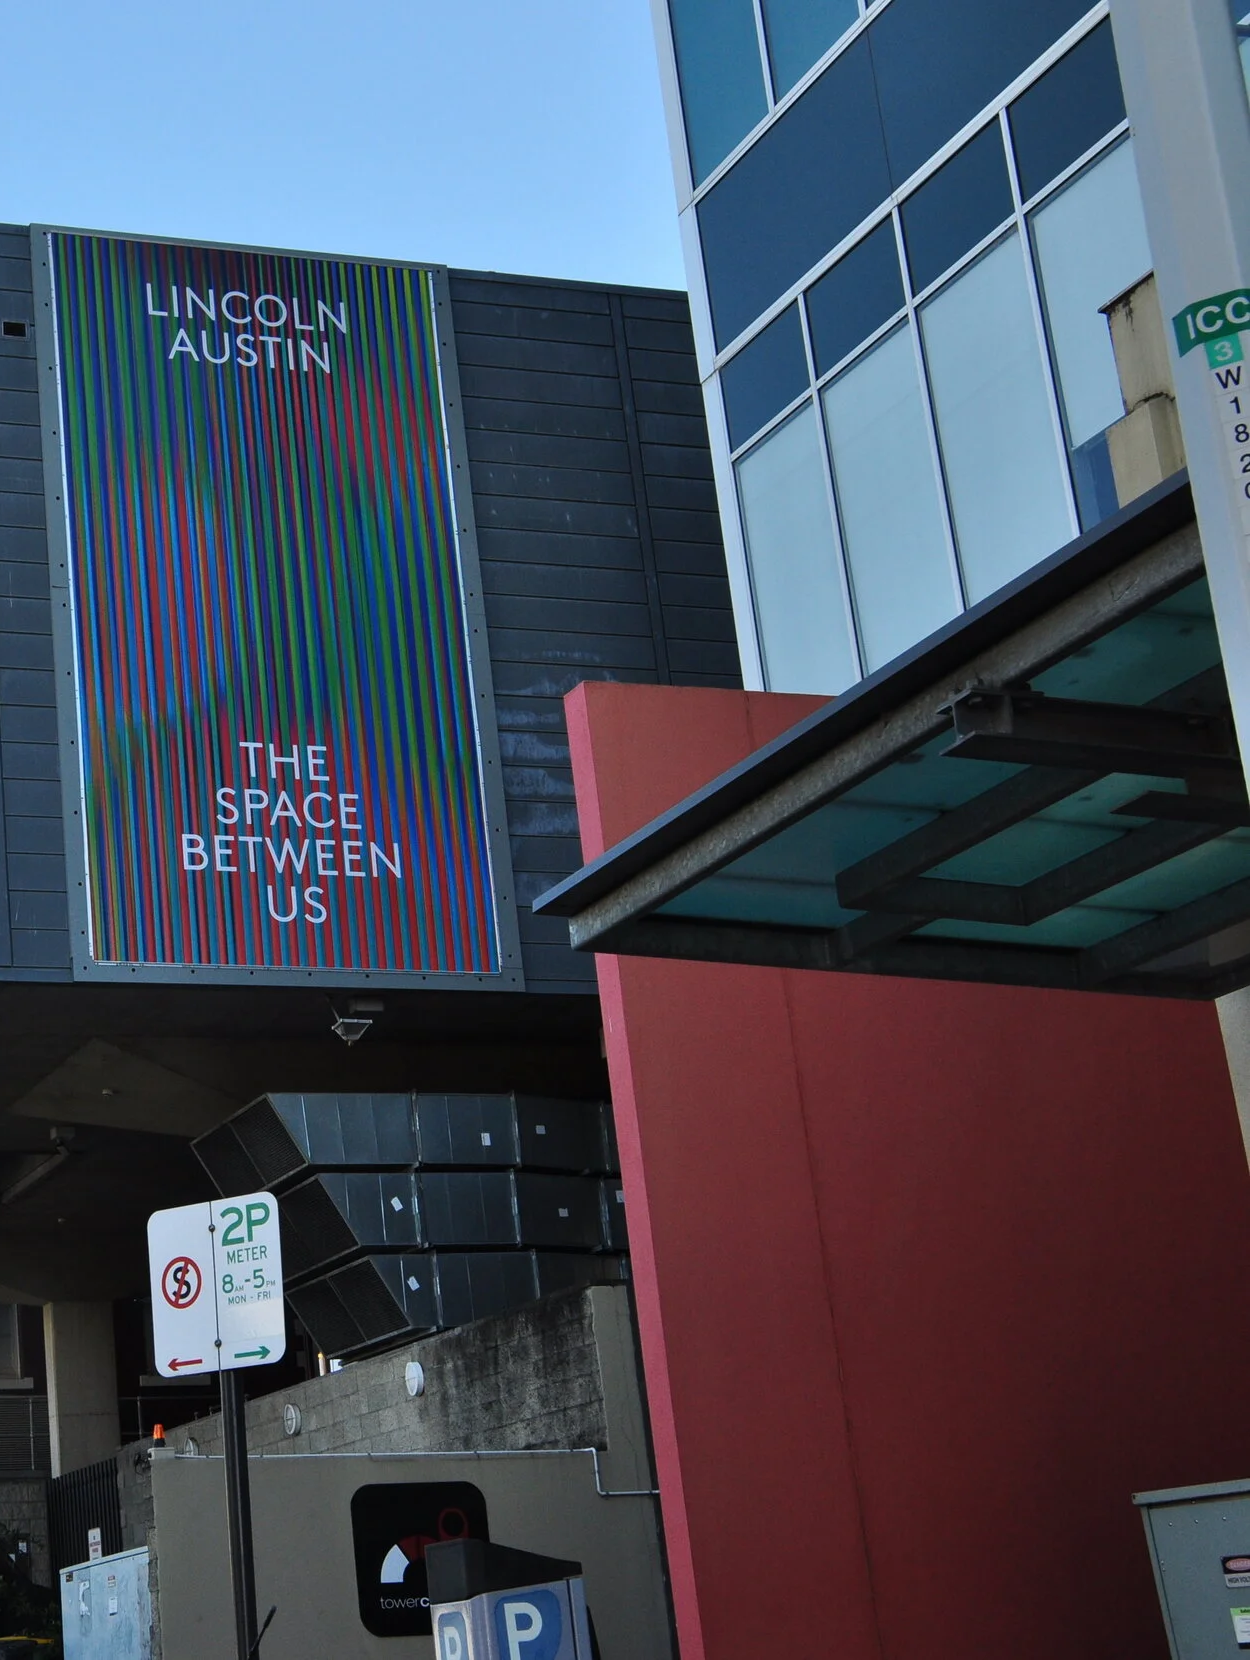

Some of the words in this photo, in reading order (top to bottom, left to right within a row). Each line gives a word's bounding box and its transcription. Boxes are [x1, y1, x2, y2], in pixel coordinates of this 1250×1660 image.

[146, 283, 347, 334] LINCOLN
[168, 328, 330, 374] AUSTIN
[1213, 341, 1234, 361] 3
[239, 742, 330, 781] THE
[216, 787, 362, 830] SPACE
[181, 833, 402, 878] BETWEEN
[267, 885, 328, 924] US
[220, 1202, 270, 1247] 2P
[226, 1246, 268, 1265] METER
[228, 1295, 247, 1305] MON
[257, 1291, 271, 1301] FRI
[380, 1596, 430, 1609] towerc
[504, 1602, 543, 1660] P
